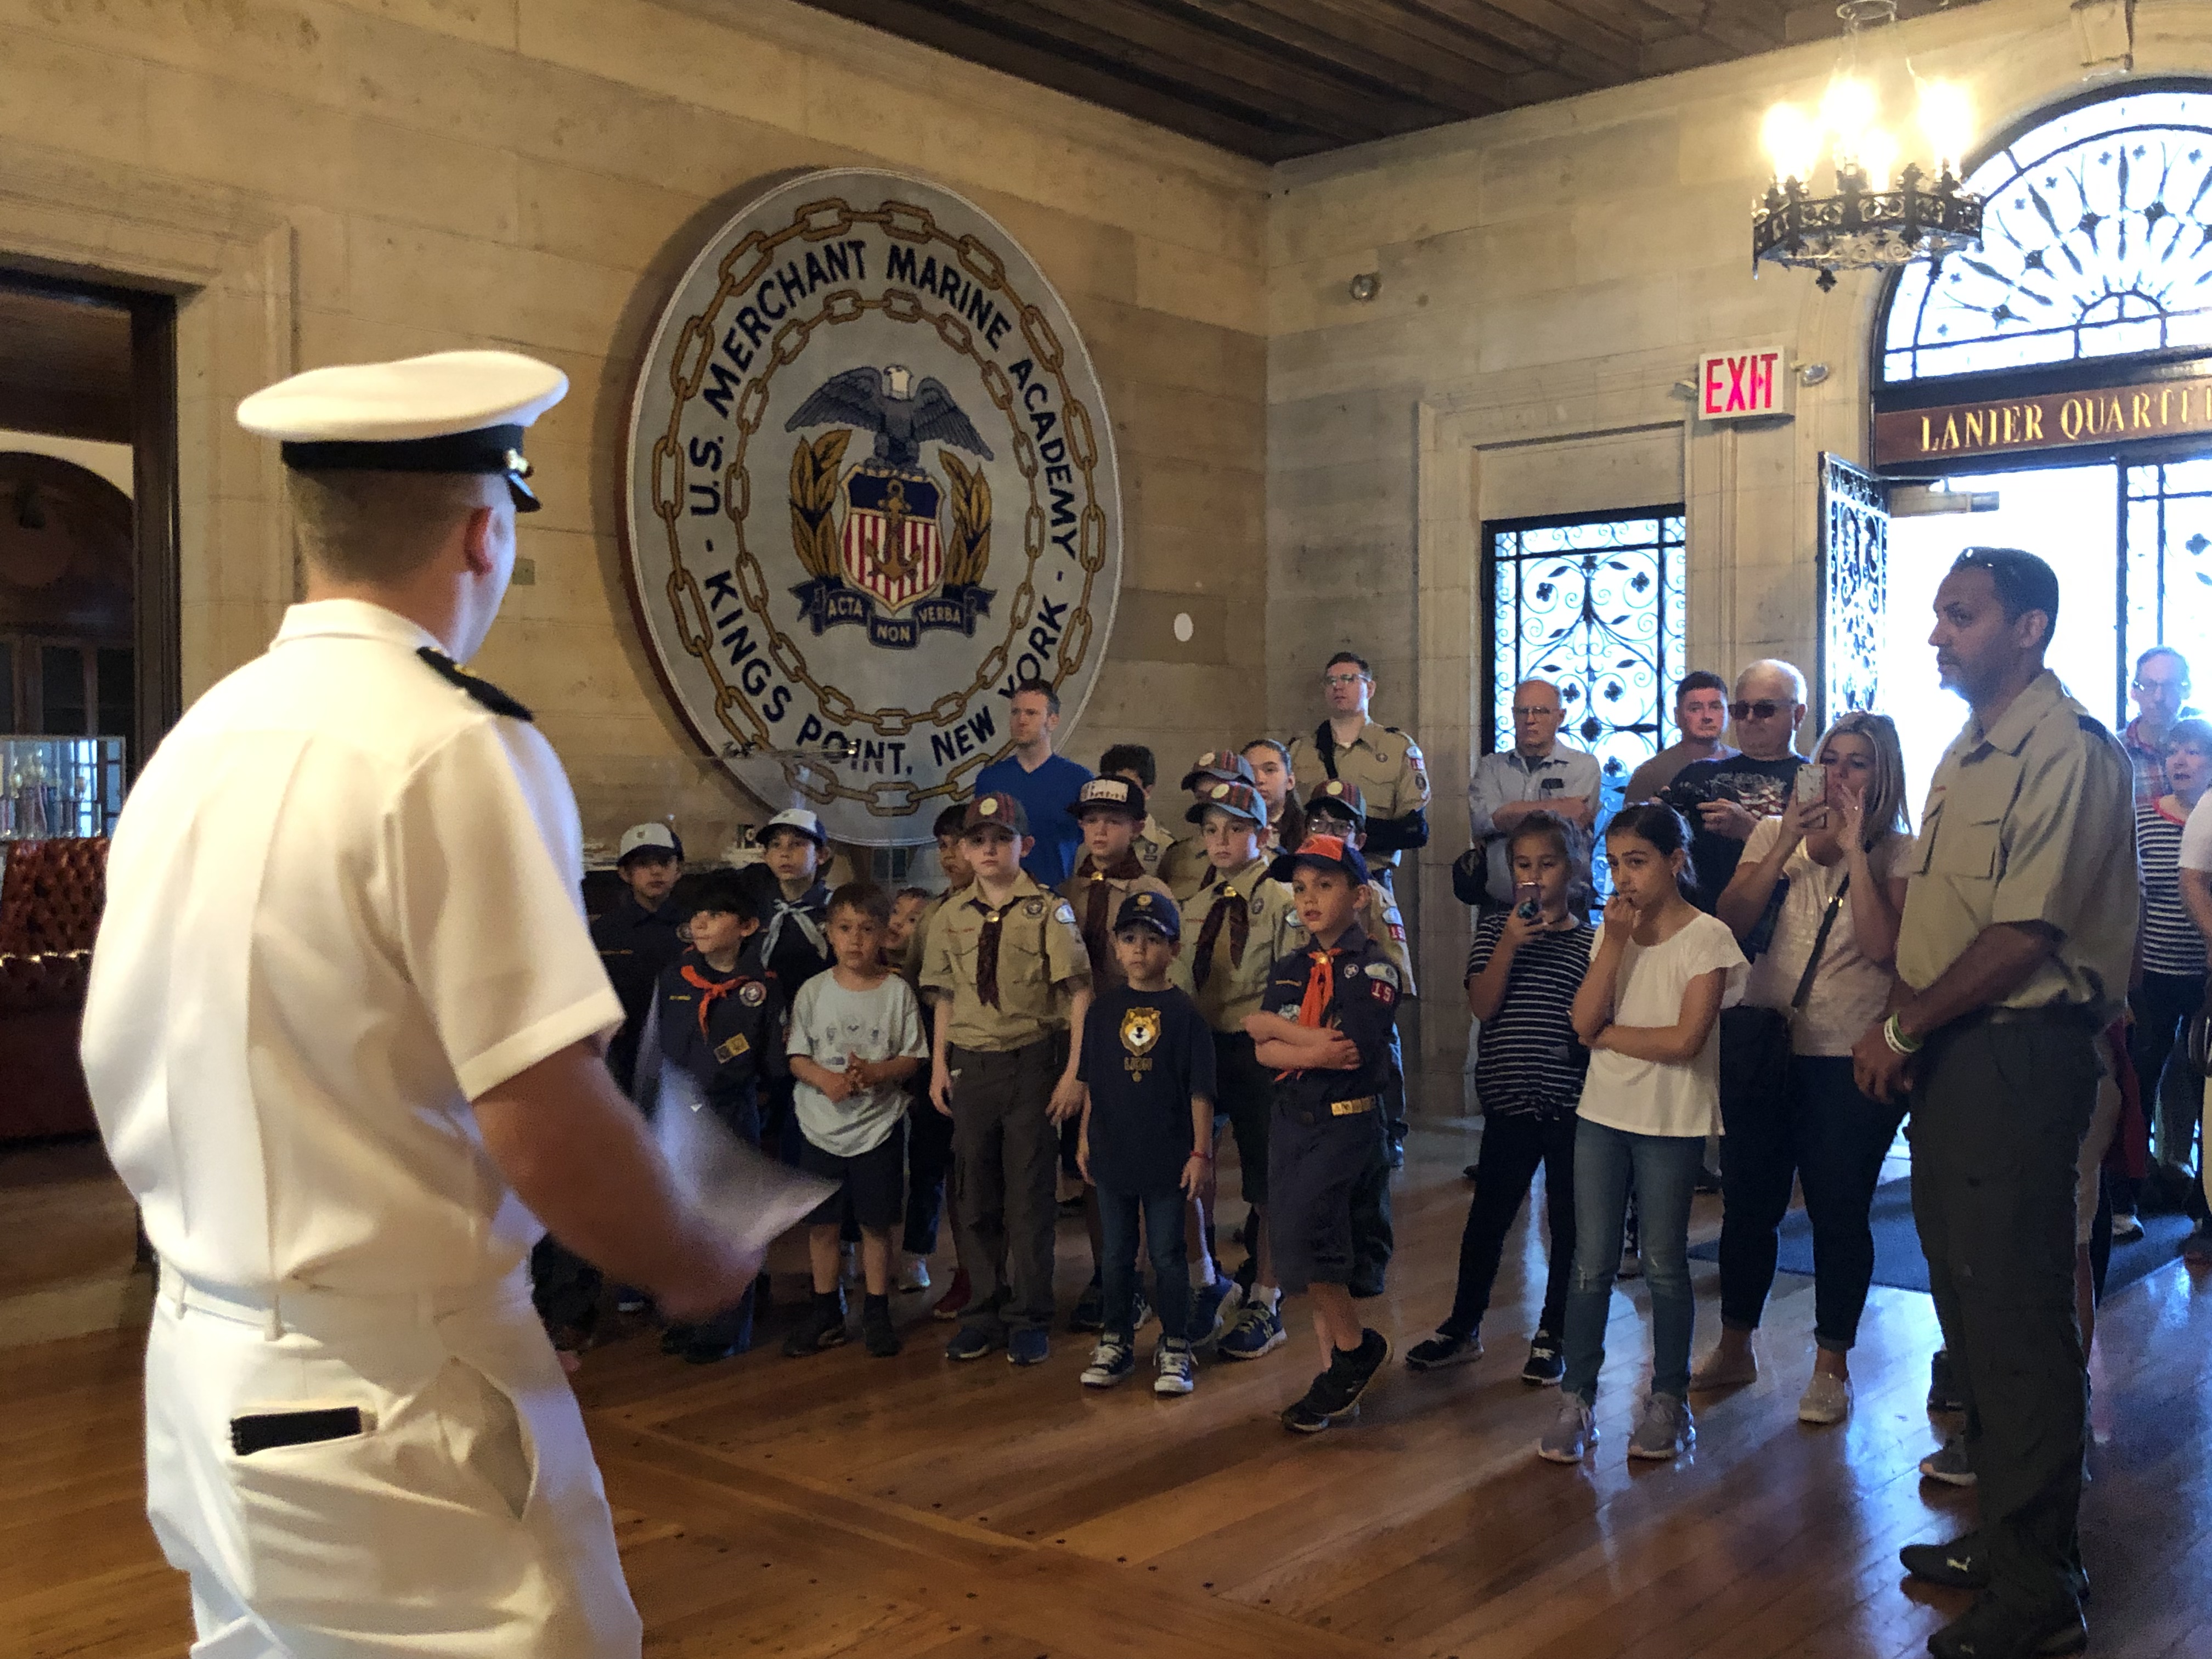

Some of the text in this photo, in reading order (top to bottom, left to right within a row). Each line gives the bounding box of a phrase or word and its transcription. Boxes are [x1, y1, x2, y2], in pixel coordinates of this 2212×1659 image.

[690, 240, 1081, 561] U.S. MERCHANT MARINE ACADEMY
[1705, 352, 1779, 414] EXIT
[1921, 404, 2045, 453] LANIER
[827, 596, 864, 618] ACTA
[918, 606, 961, 624] VERBA
[877, 625, 912, 642] NON
[704, 569, 792, 723] KINGS
[930, 705, 996, 767] NEW
[997, 595, 1068, 699] YORK
[1372, 982, 1392, 1002] 15
